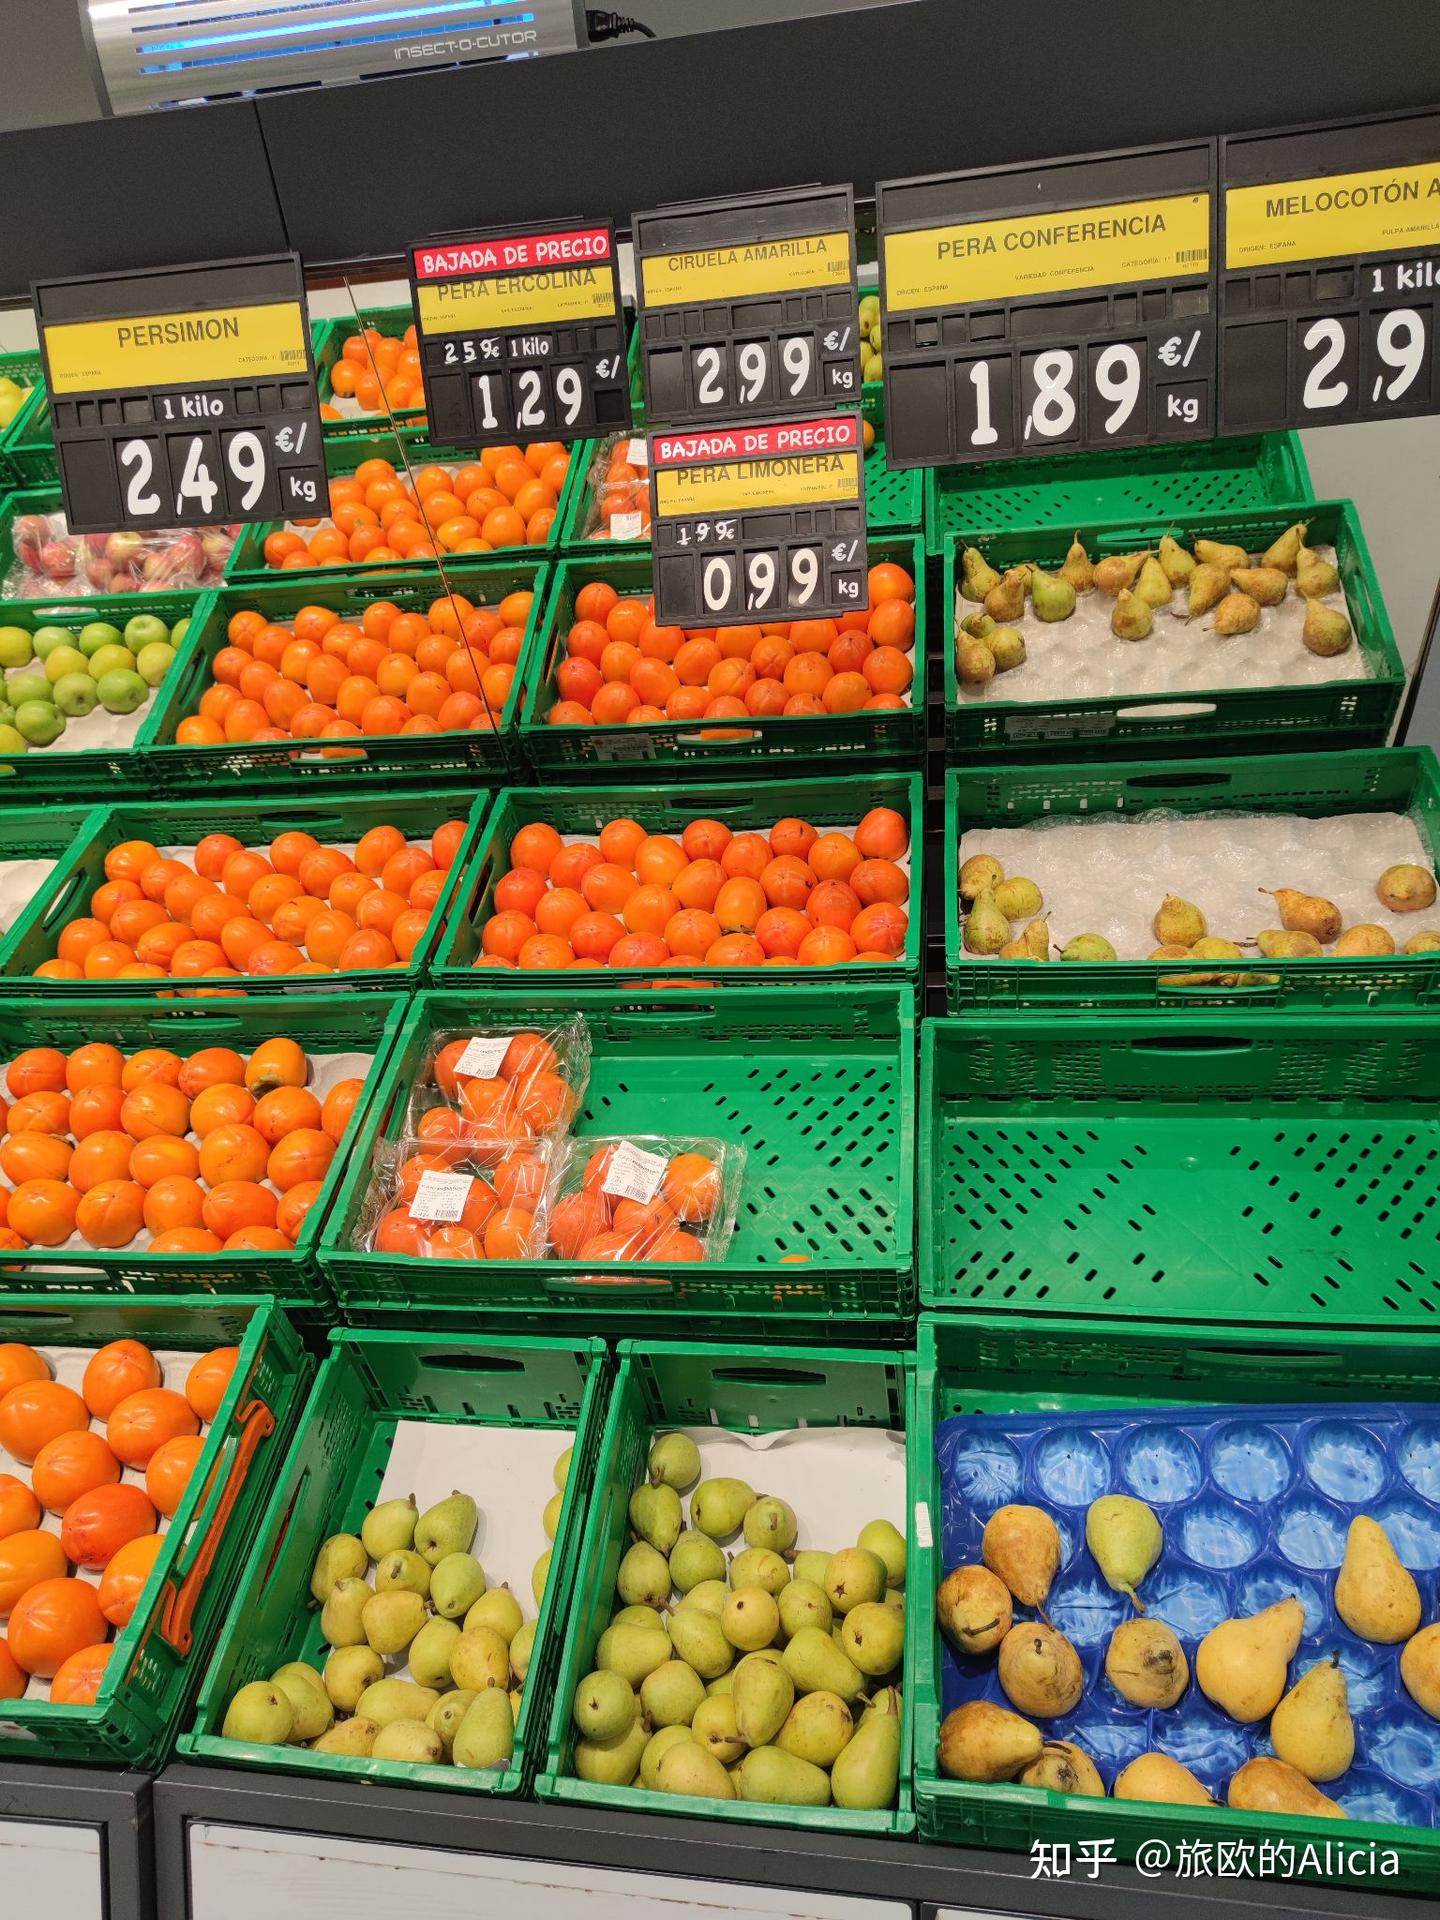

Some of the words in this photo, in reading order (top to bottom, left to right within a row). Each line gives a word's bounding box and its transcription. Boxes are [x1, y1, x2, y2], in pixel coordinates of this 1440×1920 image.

[394, 30, 537, 60] INSECT-O-CUTOR
[1266, 178, 1419, 218] MELOCOTÓN
[937, 235, 997, 260] PERA
[1003, 214, 1167, 251] CONFERENCIA
[423, 248, 498, 274] BAJADA
[504, 244, 529, 264] DE
[536, 235, 608, 261] PRECIO
[668, 250, 738, 272] CIRUELA
[743, 238, 828, 262] AMARILLA
[437, 280, 490, 302] PERA
[495, 267, 597, 295] ERCOLINA
[1372, 268, 1385, 293] 1
[117, 317, 240, 348] PERSIMON
[511, 339, 518, 357] 1
[522, 336, 549, 356] kilo
[697, 337, 810, 404] 2,99
[823, 327, 850, 352] €/
[1303, 308, 1426, 410] 2,9
[478, 367, 582, 430] 1,29
[595, 354, 621, 380] €/
[832, 368, 854, 389] kg
[969, 343, 1141, 446] 1,89
[1157, 329, 1201, 367] €/
[164, 398, 175, 420] 1
[181, 395, 225, 418] kilo
[1167, 393, 1199, 423] kg
[660, 438, 737, 459] BAJADA
[743, 433, 769, 451] DE
[777, 425, 850, 448] PRECIO
[121, 431, 266, 516] 2,49
[275, 422, 308, 454] €/
[677, 464, 730, 486] PERA
[738, 454, 844, 480] LIMONERA
[290, 476, 318, 502] kg
[703, 548, 819, 611] 0,99
[831, 539, 859, 562] €/
[838, 579, 859, 598] kg
